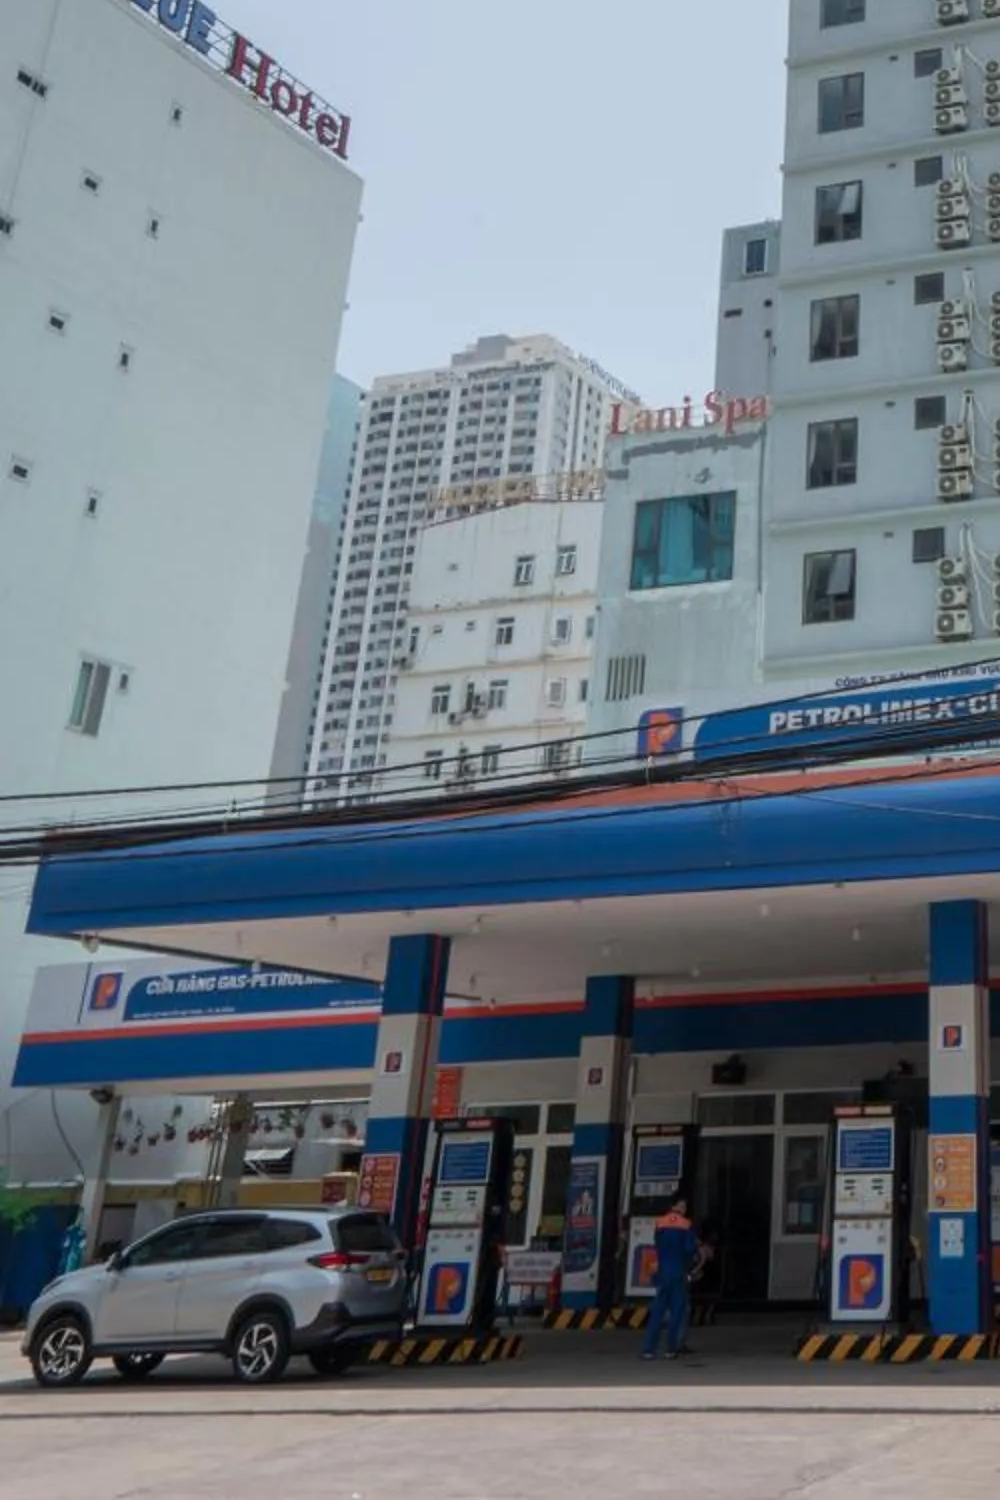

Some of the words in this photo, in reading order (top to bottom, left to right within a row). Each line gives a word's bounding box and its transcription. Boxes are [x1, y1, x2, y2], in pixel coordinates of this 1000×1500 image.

[226, 35, 351, 159] Hotel
[609, 396, 692, 435] Lani
[704, 388, 772, 437] Spa
